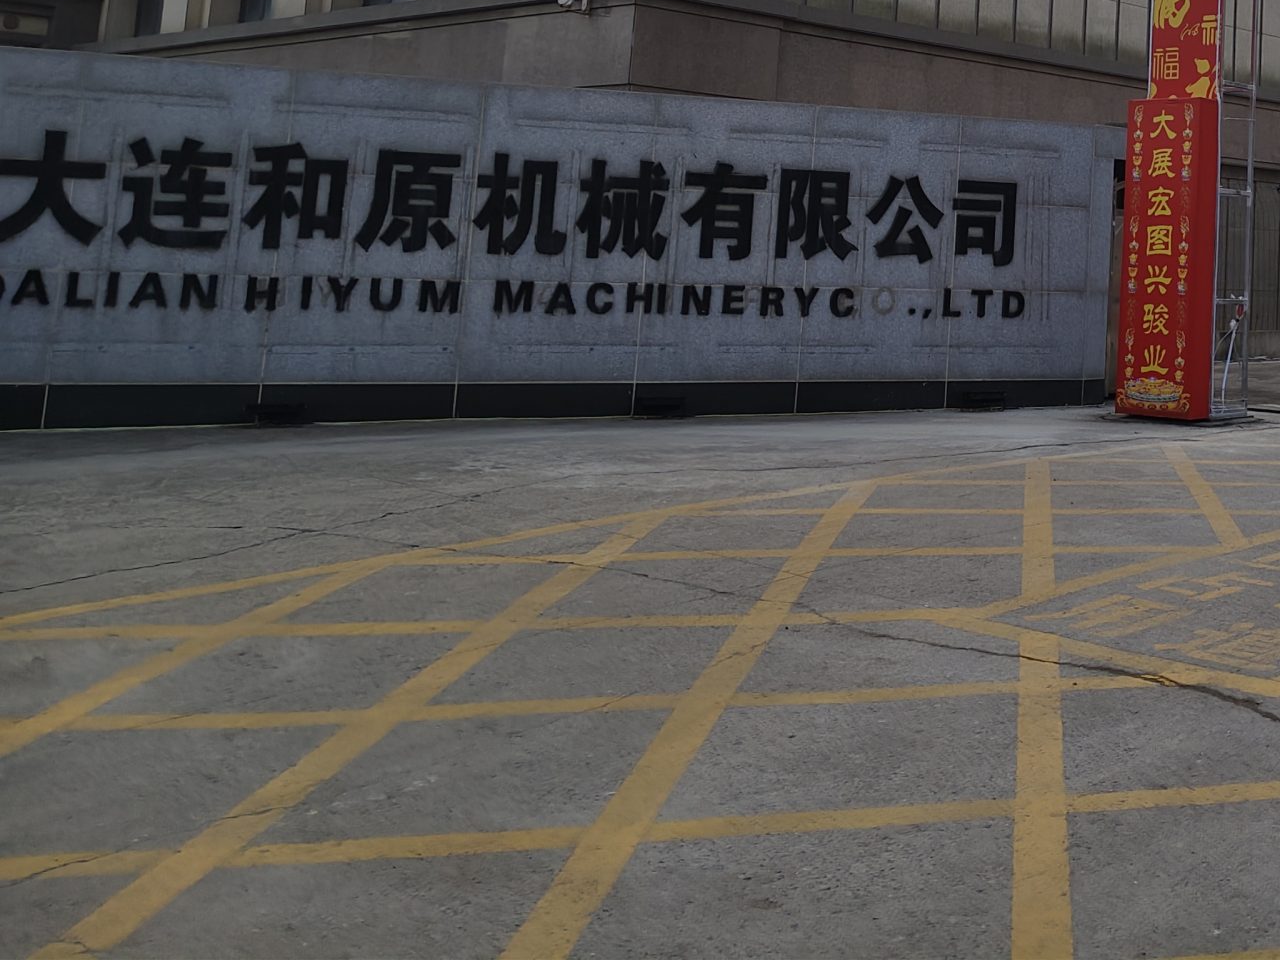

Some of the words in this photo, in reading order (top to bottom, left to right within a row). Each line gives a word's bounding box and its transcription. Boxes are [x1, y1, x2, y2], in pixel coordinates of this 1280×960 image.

[0, 129, 1018, 267] 大连和原机械有限公司
[1140, 109, 1177, 374] 大展宏图兴骏业
[0, 268, 219, 309] ALIAN
[244, 275, 461, 315] HIYUM
